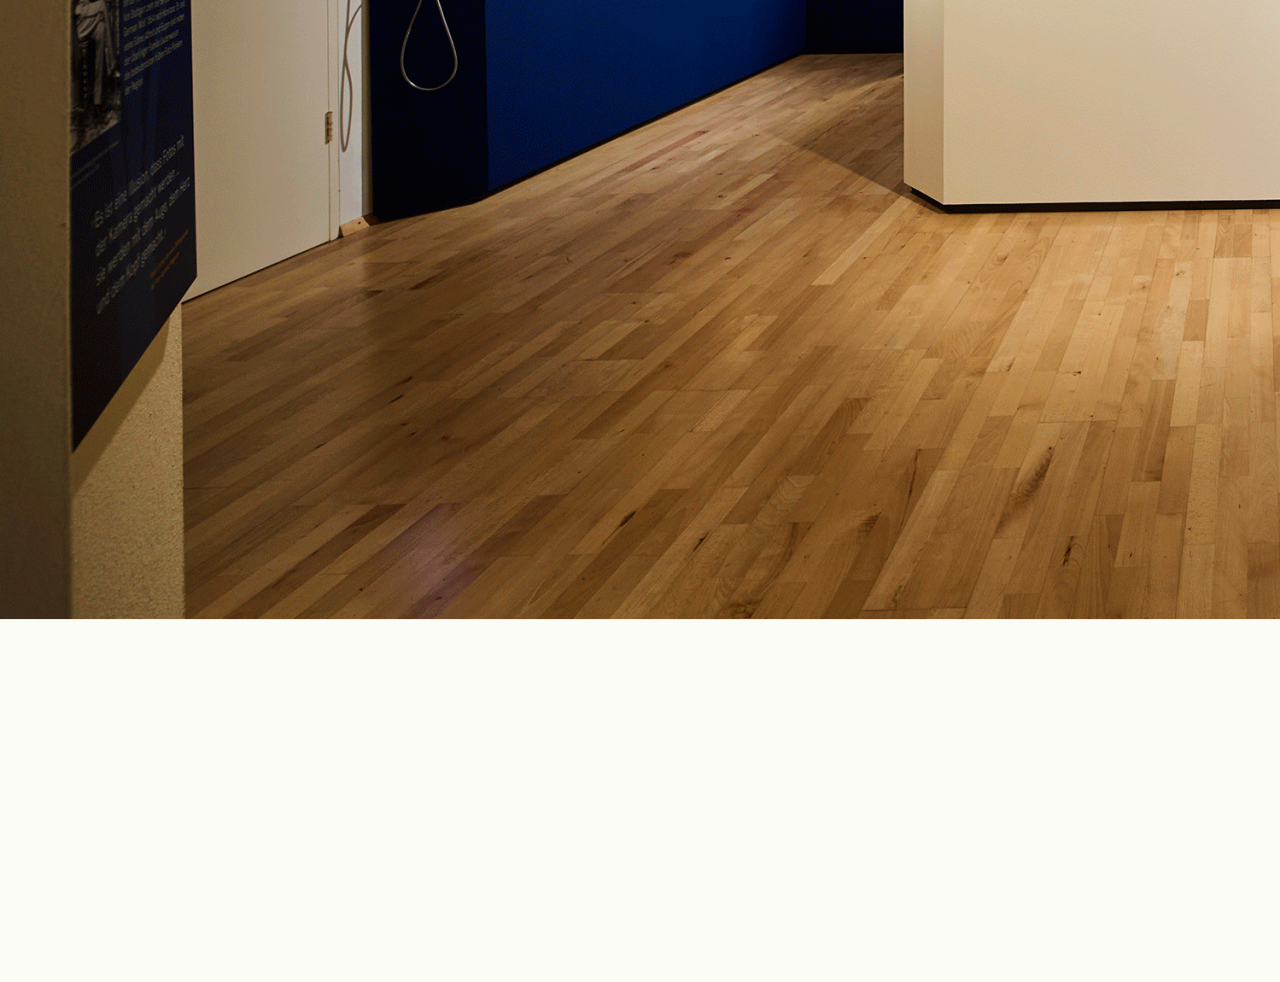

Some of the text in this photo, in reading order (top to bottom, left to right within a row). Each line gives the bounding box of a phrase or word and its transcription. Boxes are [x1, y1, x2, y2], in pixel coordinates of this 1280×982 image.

[95, 235, 108, 258] der
[109, 212, 134, 244] Kamera
[133, 186, 158, 223] gemacht
[105, 201, 113, 219] ist
[114, 189, 128, 211] eine
[96, 266, 107, 287] sie
[108, 240, 131, 274] werden
